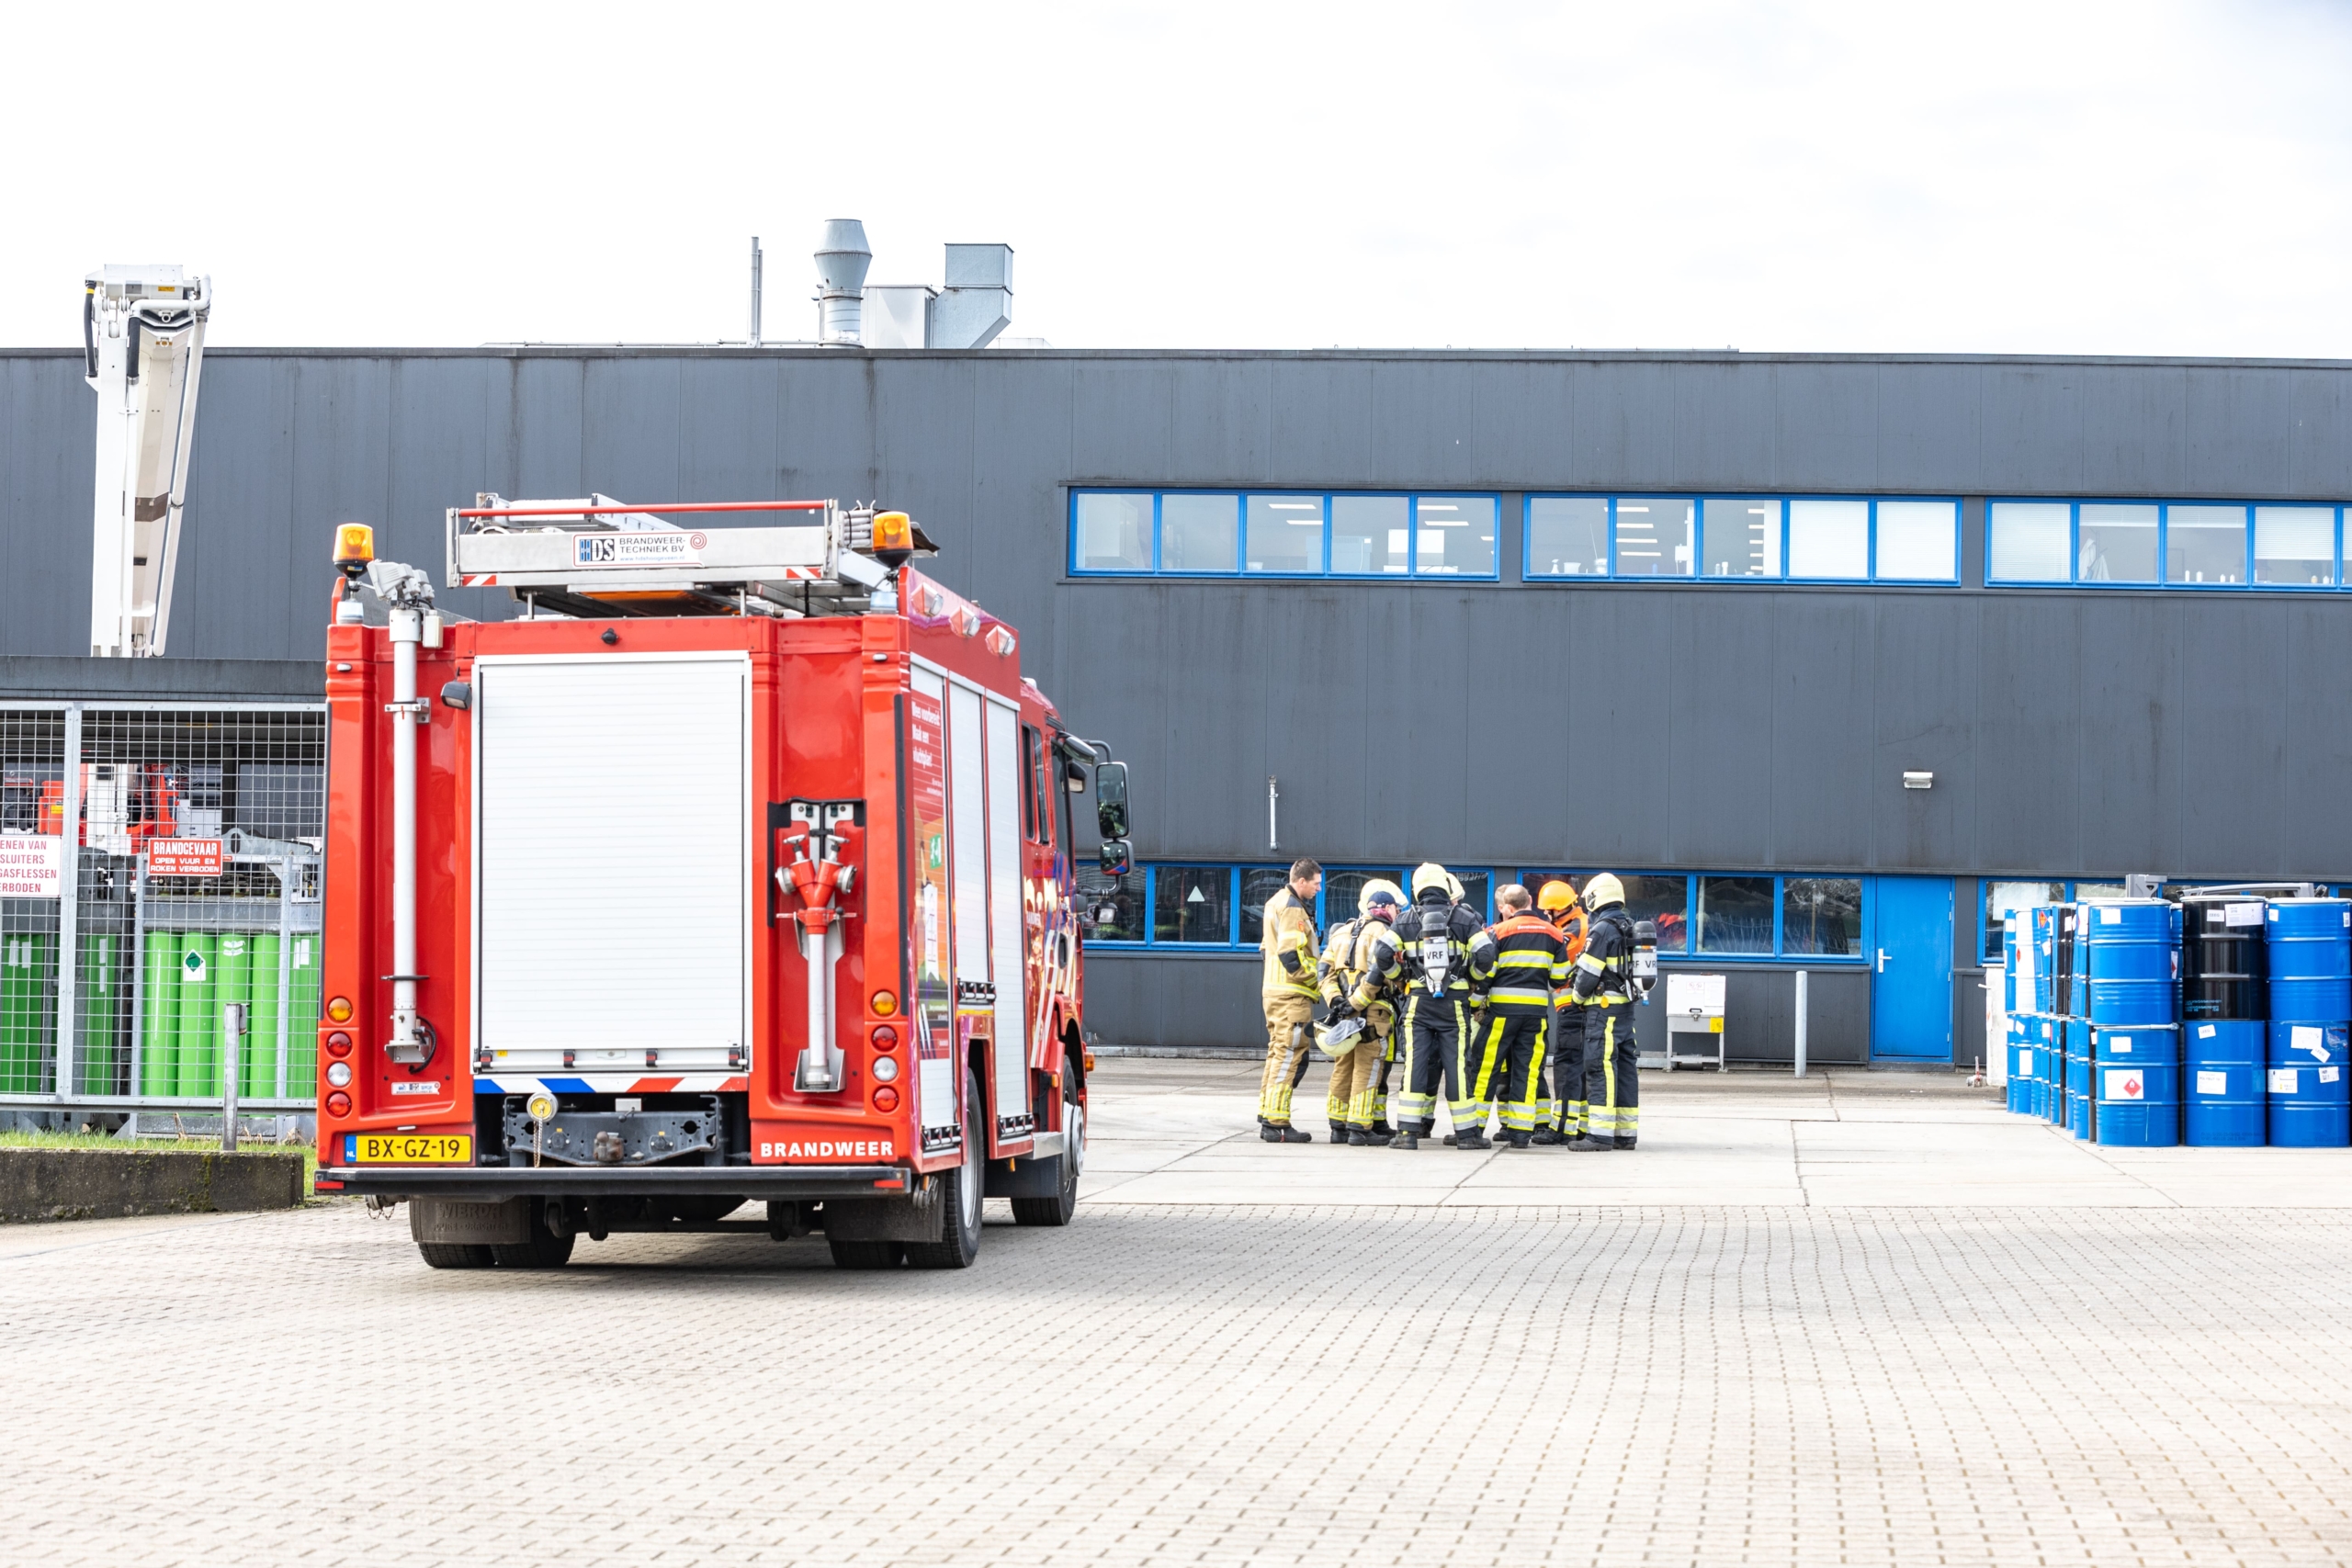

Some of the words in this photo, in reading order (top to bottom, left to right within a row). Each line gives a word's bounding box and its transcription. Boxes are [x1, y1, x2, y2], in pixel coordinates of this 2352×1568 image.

[619, 536, 686, 546] BRANDWEER-
[580, 538, 615, 561] HDS
[28, 840, 47, 851] VAN
[153, 841, 218, 855] BRANDGEVAAR
[0, 853, 45, 864] SLUITERS
[0, 882, 41, 893] RBODEN
[1426, 951, 1443, 960] VRF
[368, 1139, 460, 1157] BX-GZ-19
[761, 1141, 893, 1157] BRANDWEER
